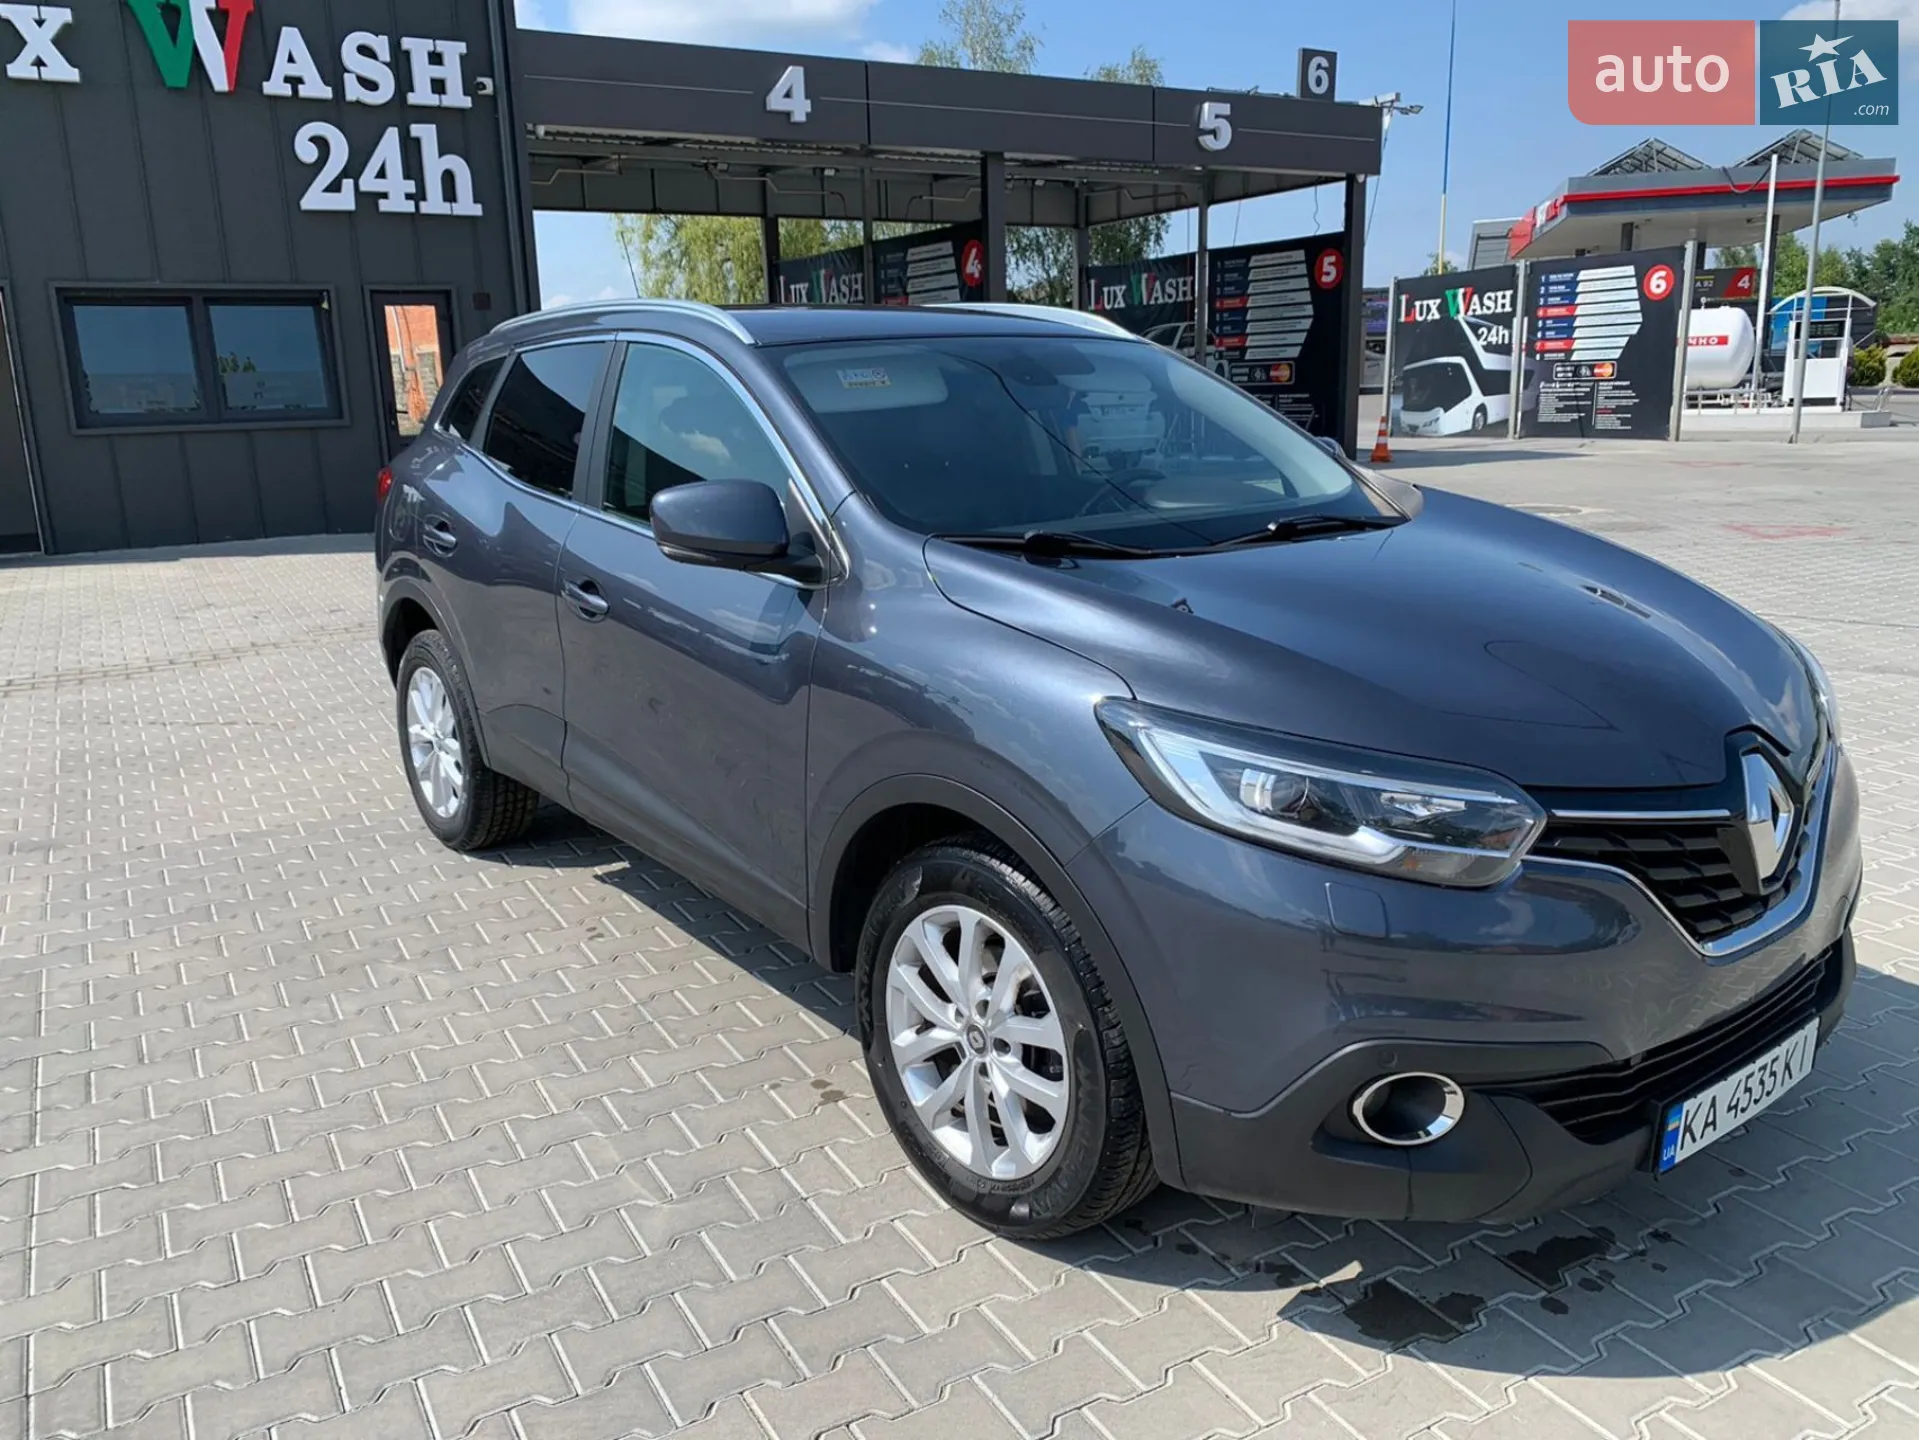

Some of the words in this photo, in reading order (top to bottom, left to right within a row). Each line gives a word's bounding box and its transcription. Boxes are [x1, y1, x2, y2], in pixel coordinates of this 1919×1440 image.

[127, 0, 472, 108] WASH
[765, 65, 812, 123] 4
[1307, 56, 1330, 96] 6
[1197, 101, 1233, 152] 5
[294, 121, 483, 216] 24h
[965, 248, 982, 278] 4
[1321, 255, 1337, 283] 5
[780, 275, 809, 304] LUX
[812, 268, 864, 304] WASH
[1088, 279, 1127, 310] LUX
[1130, 272, 1193, 305] WASH
[1649, 270, 1668, 295] 6
[1737, 274, 1750, 290] 4
[1398, 294, 1441, 322] LUX
[1445, 287, 1513, 318] WASH
[1478, 325, 1510, 346] 24h
